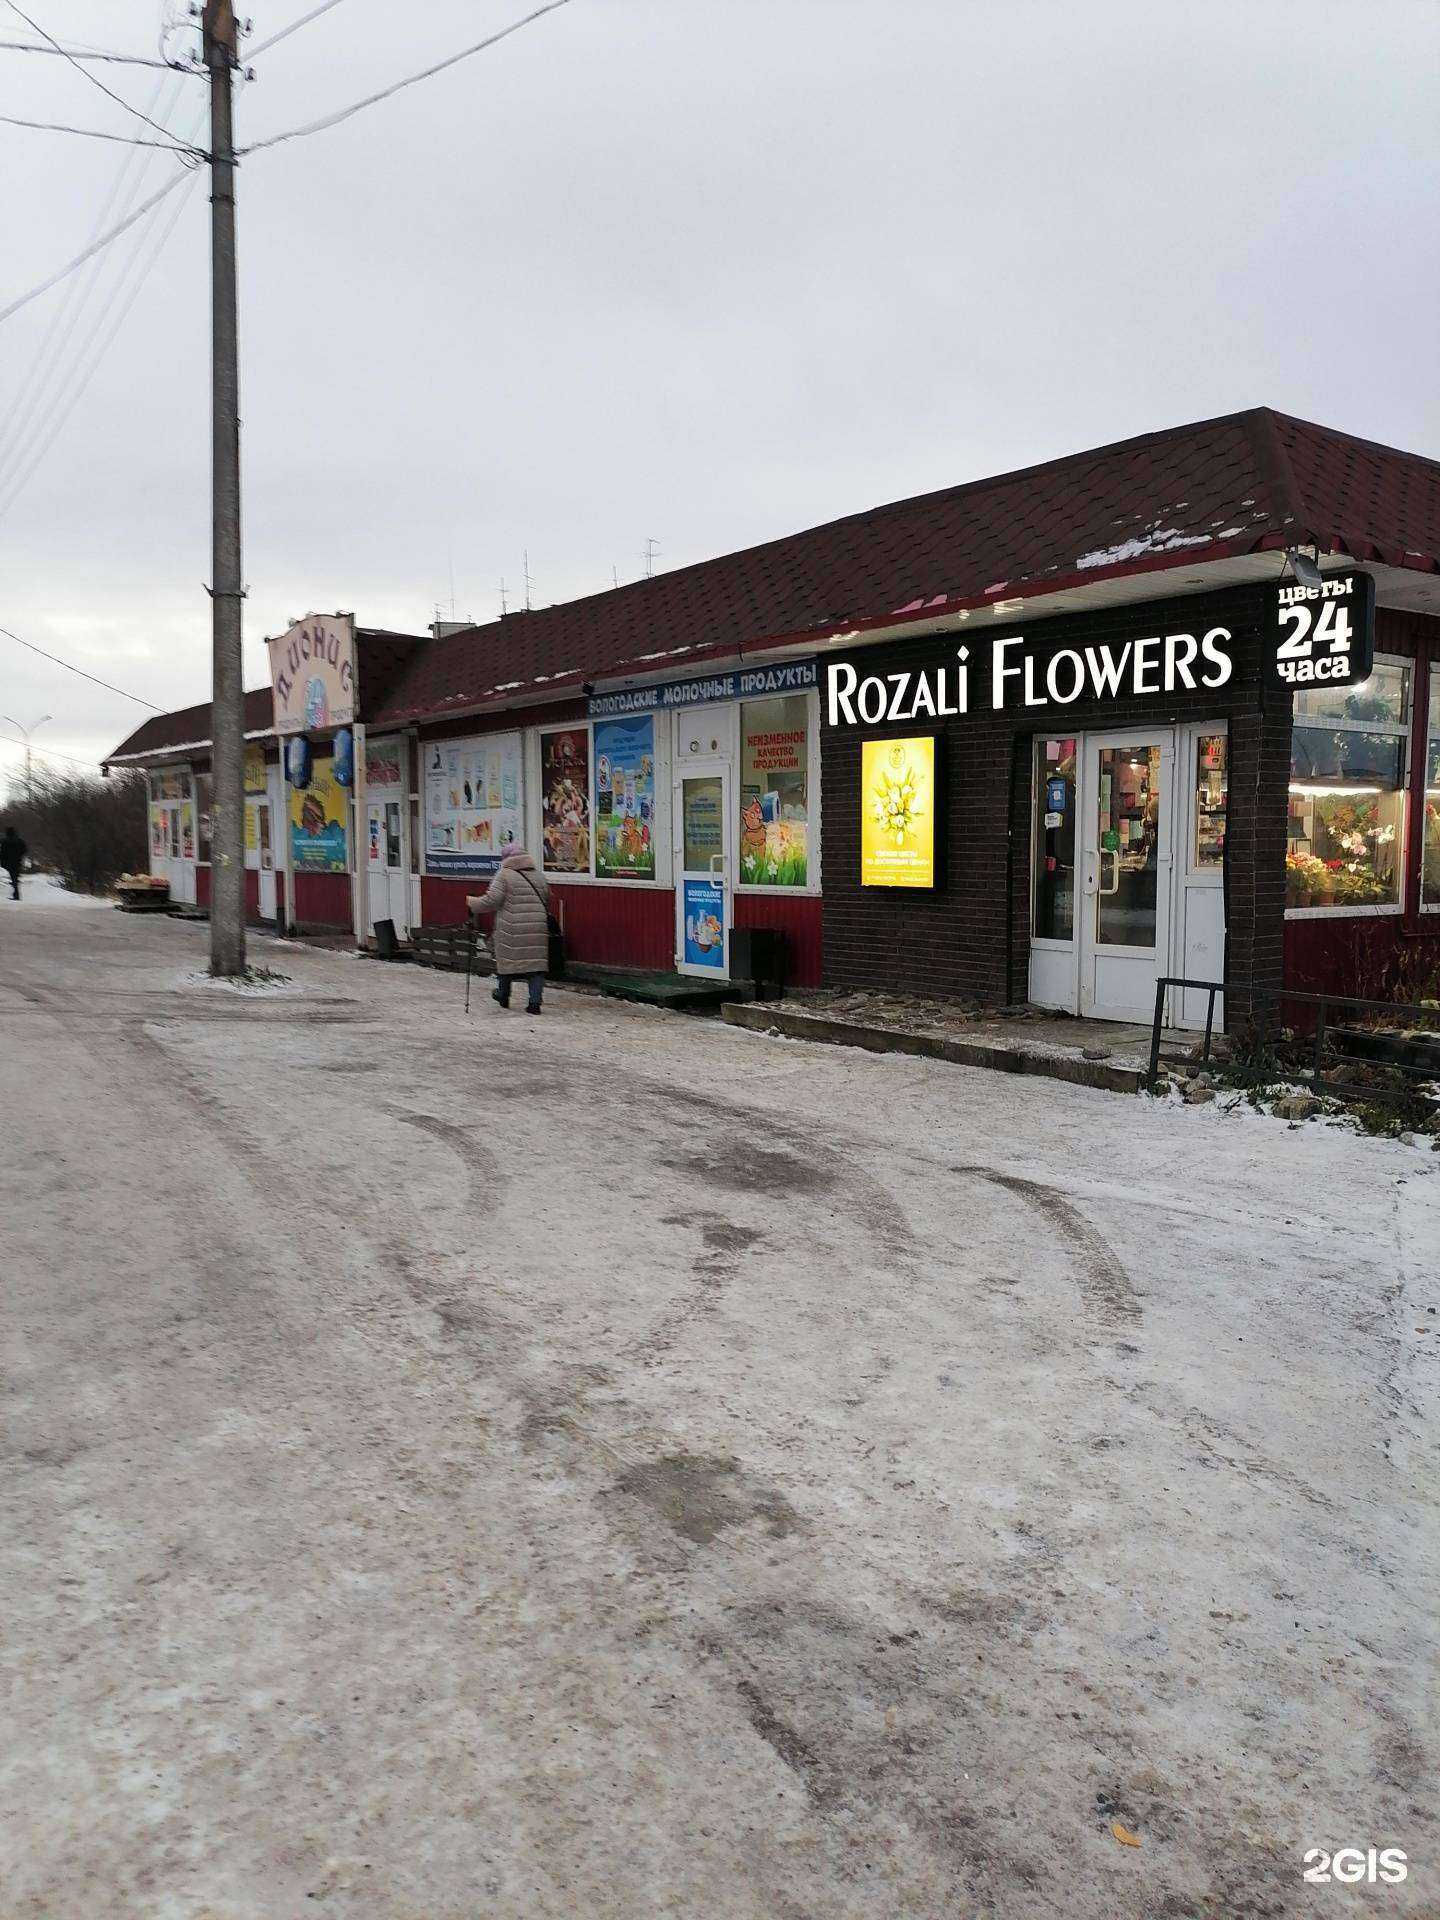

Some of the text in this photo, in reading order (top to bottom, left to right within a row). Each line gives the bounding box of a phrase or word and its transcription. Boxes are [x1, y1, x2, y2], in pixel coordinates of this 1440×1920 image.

[1279, 578, 1353, 606] цветы
[1277, 601, 1353, 659] 24
[992, 627, 1233, 710] FLOWERS
[1276, 655, 1351, 683] часа
[589, 664, 817, 714] ВОЛОГОДСКИЕ МОЛОЧНЫЕ ПРОДУКТЫ
[747, 731, 805, 747] НЕИЗМЕННОЕ
[757, 746, 794, 758] КАЧЕСТВО
[752, 757, 799, 769] ПРОДУКЦИИ
